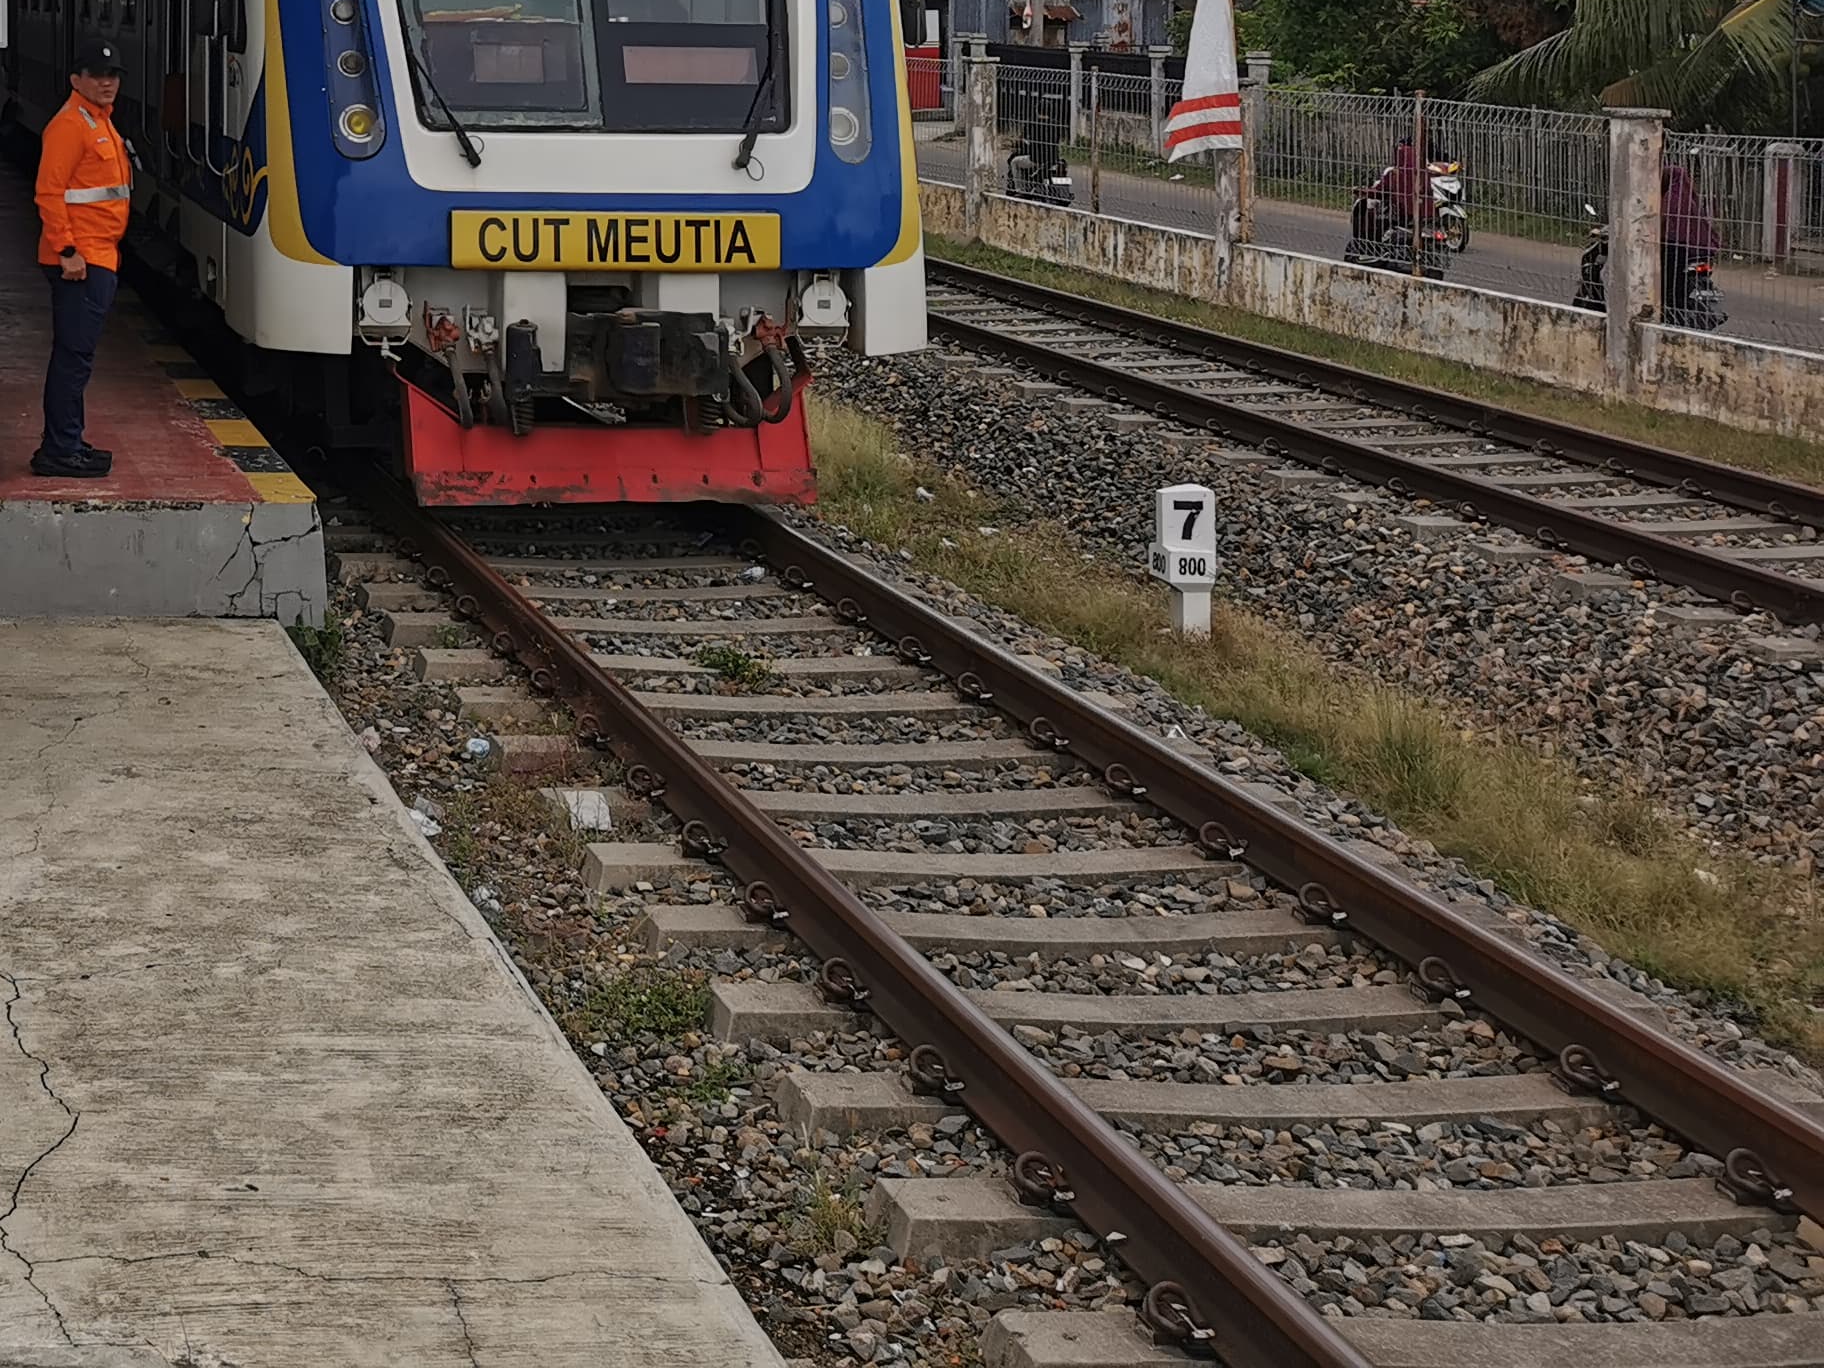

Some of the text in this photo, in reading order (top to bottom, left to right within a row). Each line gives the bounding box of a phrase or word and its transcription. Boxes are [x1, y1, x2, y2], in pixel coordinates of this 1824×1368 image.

[478, 217, 756, 264] CUT MEUTIA
[1173, 500, 1204, 540] 7
[1179, 557, 1206, 576] 800
